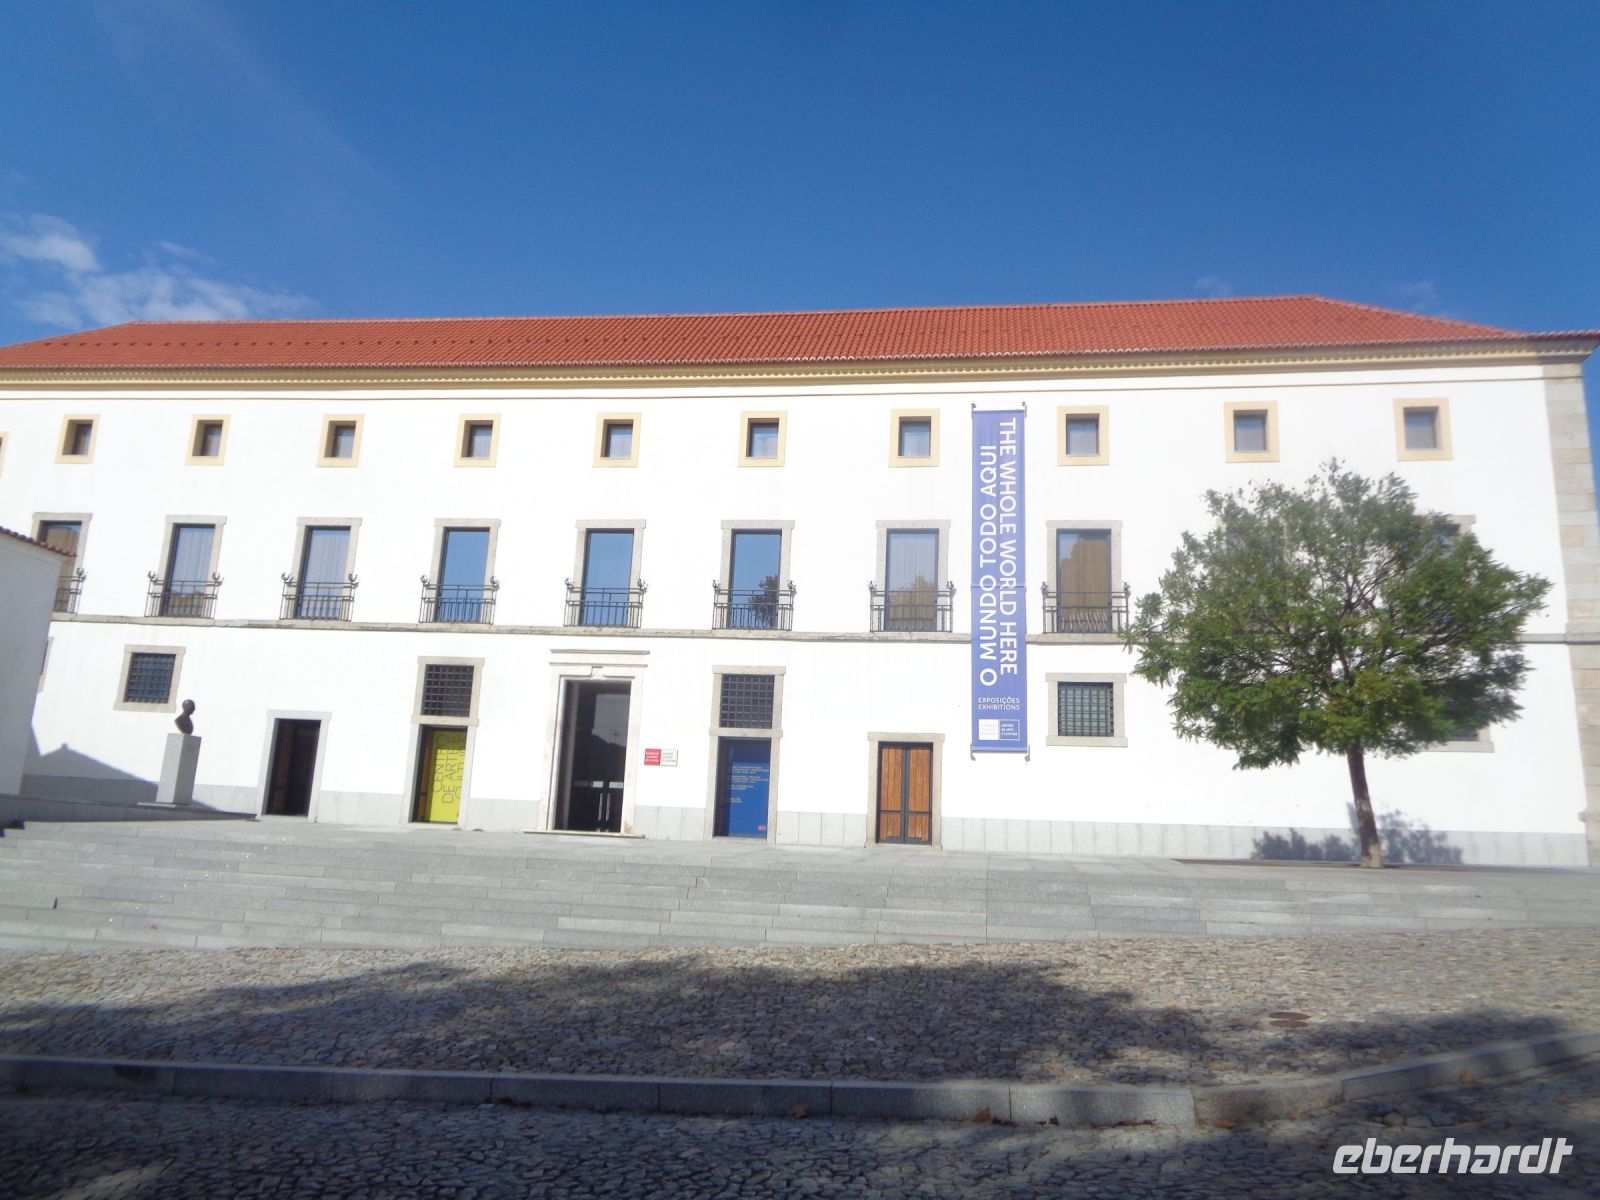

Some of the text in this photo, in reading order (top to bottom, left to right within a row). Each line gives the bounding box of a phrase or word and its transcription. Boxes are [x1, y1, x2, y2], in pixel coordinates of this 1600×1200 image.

[980, 445, 997, 686] O MUNDO TODO AQUI
[1000, 417, 1018, 675] THE WHOLE WORLD HERE
[978, 696, 1020, 704] EXPOSIÇÕES
[433, 735, 447, 793] CENTRO
[444, 747, 459, 780] ARTE
[442, 784, 455, 804] DE
